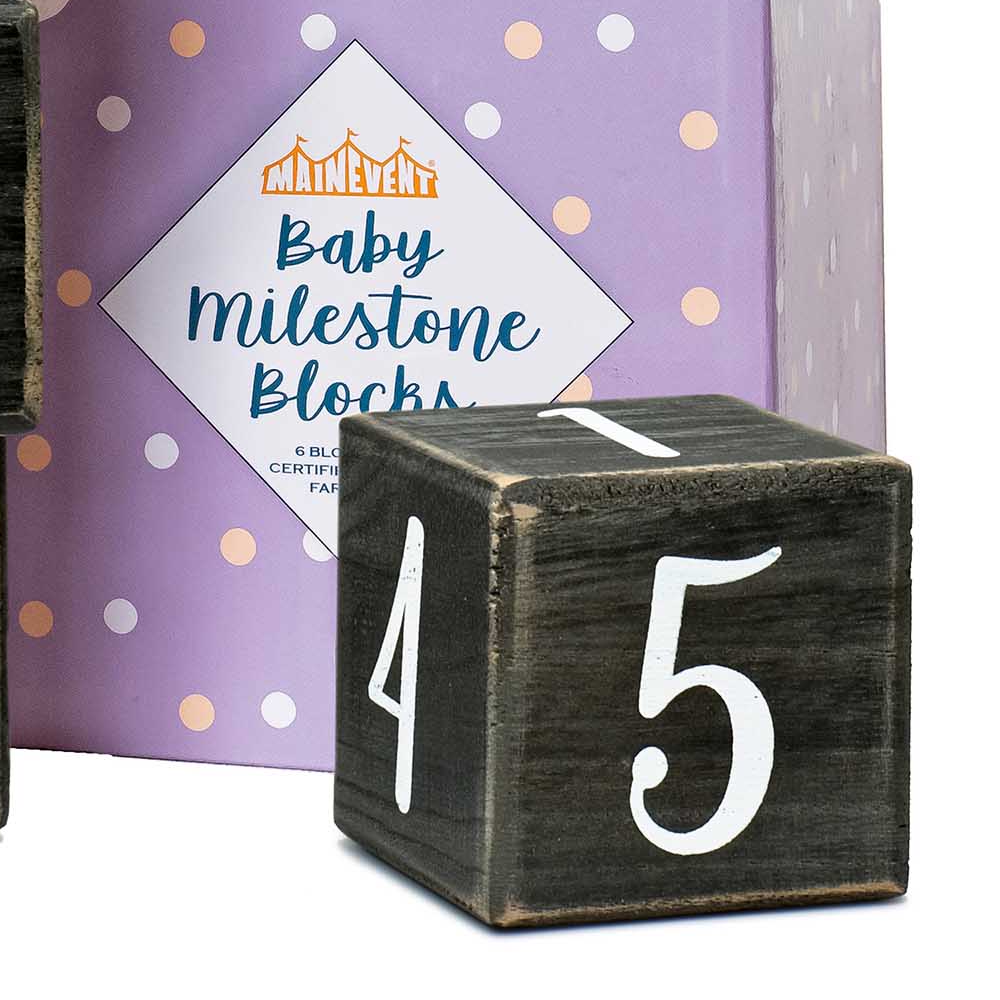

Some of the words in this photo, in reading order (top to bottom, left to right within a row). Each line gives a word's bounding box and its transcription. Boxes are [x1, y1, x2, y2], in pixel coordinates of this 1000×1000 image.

[265, 149, 435, 196] MAINEVENT
[276, 210, 444, 279] Baby
[188, 284, 540, 363] Milestone
[295, 445, 305, 457] 6
[367, 515, 425, 813] 4
[629, 546, 782, 856] 5
